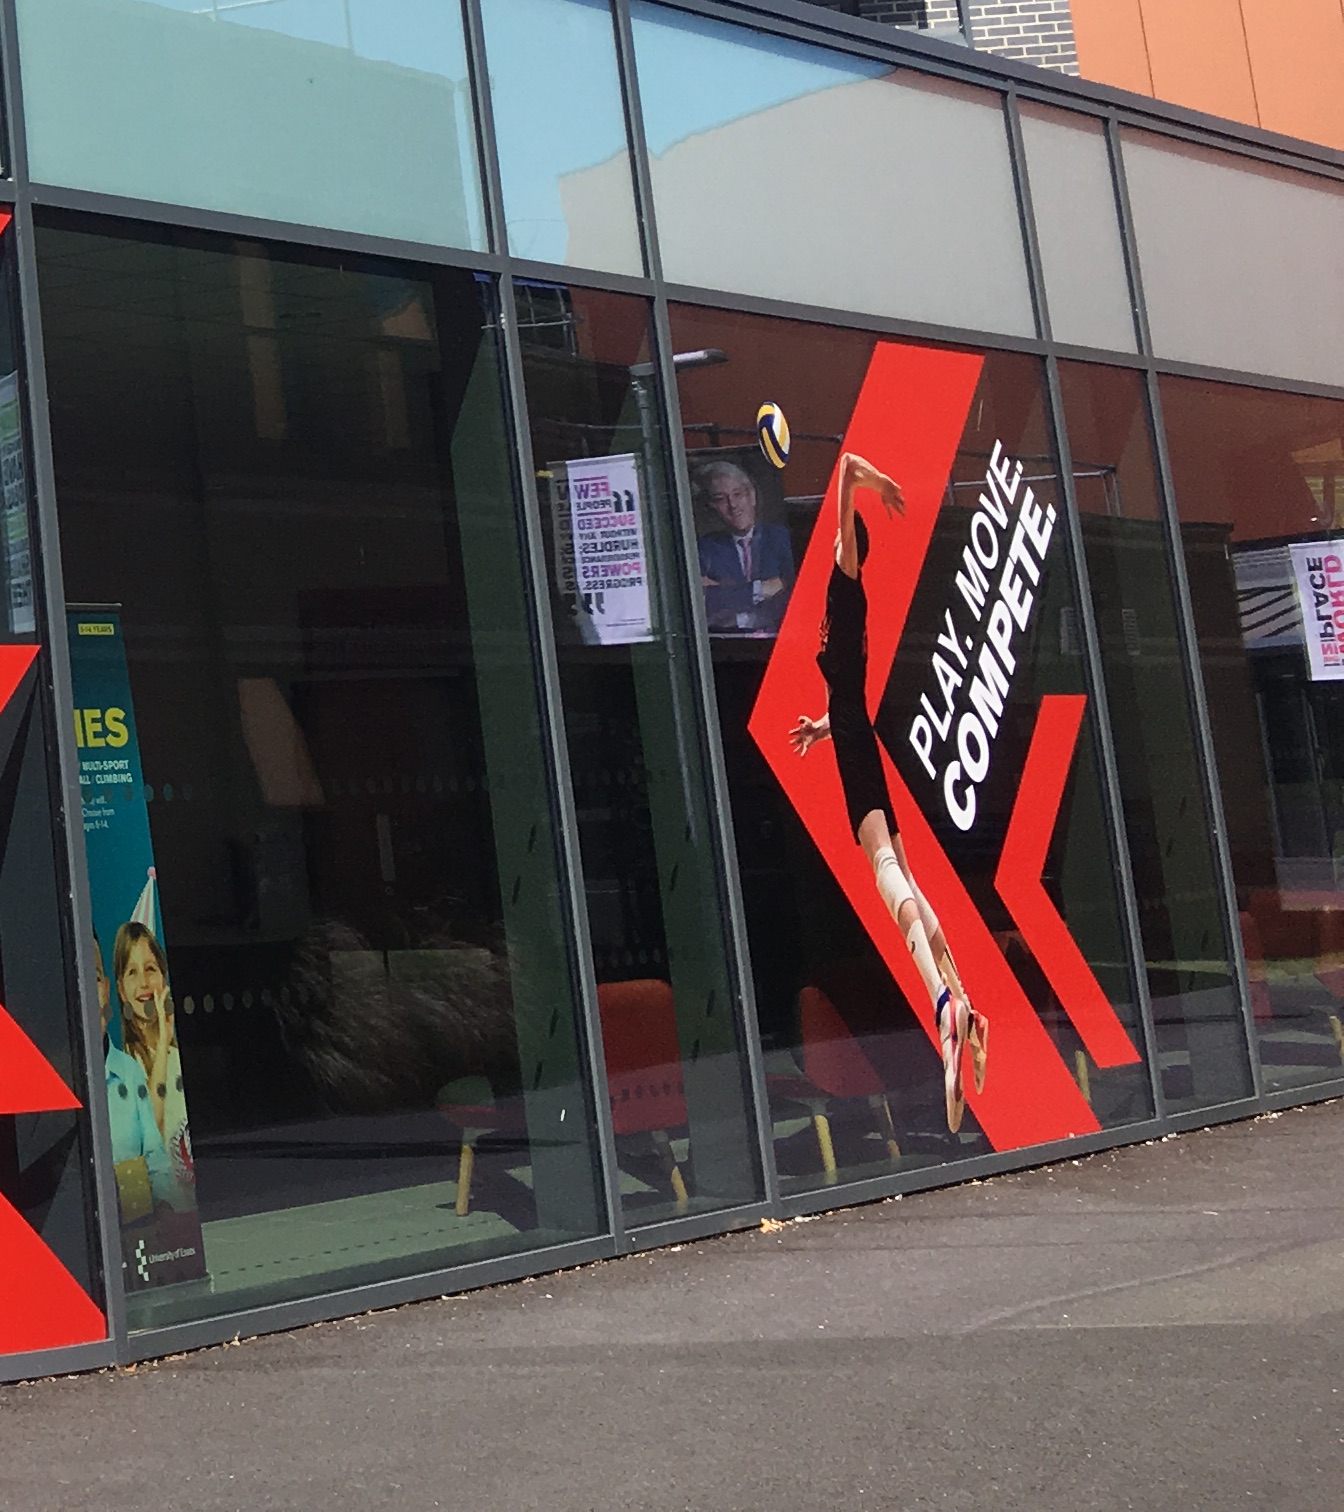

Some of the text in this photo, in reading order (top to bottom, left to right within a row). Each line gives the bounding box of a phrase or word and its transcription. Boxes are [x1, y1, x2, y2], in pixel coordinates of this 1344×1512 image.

[909, 439, 1023, 780] PLAY. MOVE.
[944, 487, 1057, 831] COMPETE.
